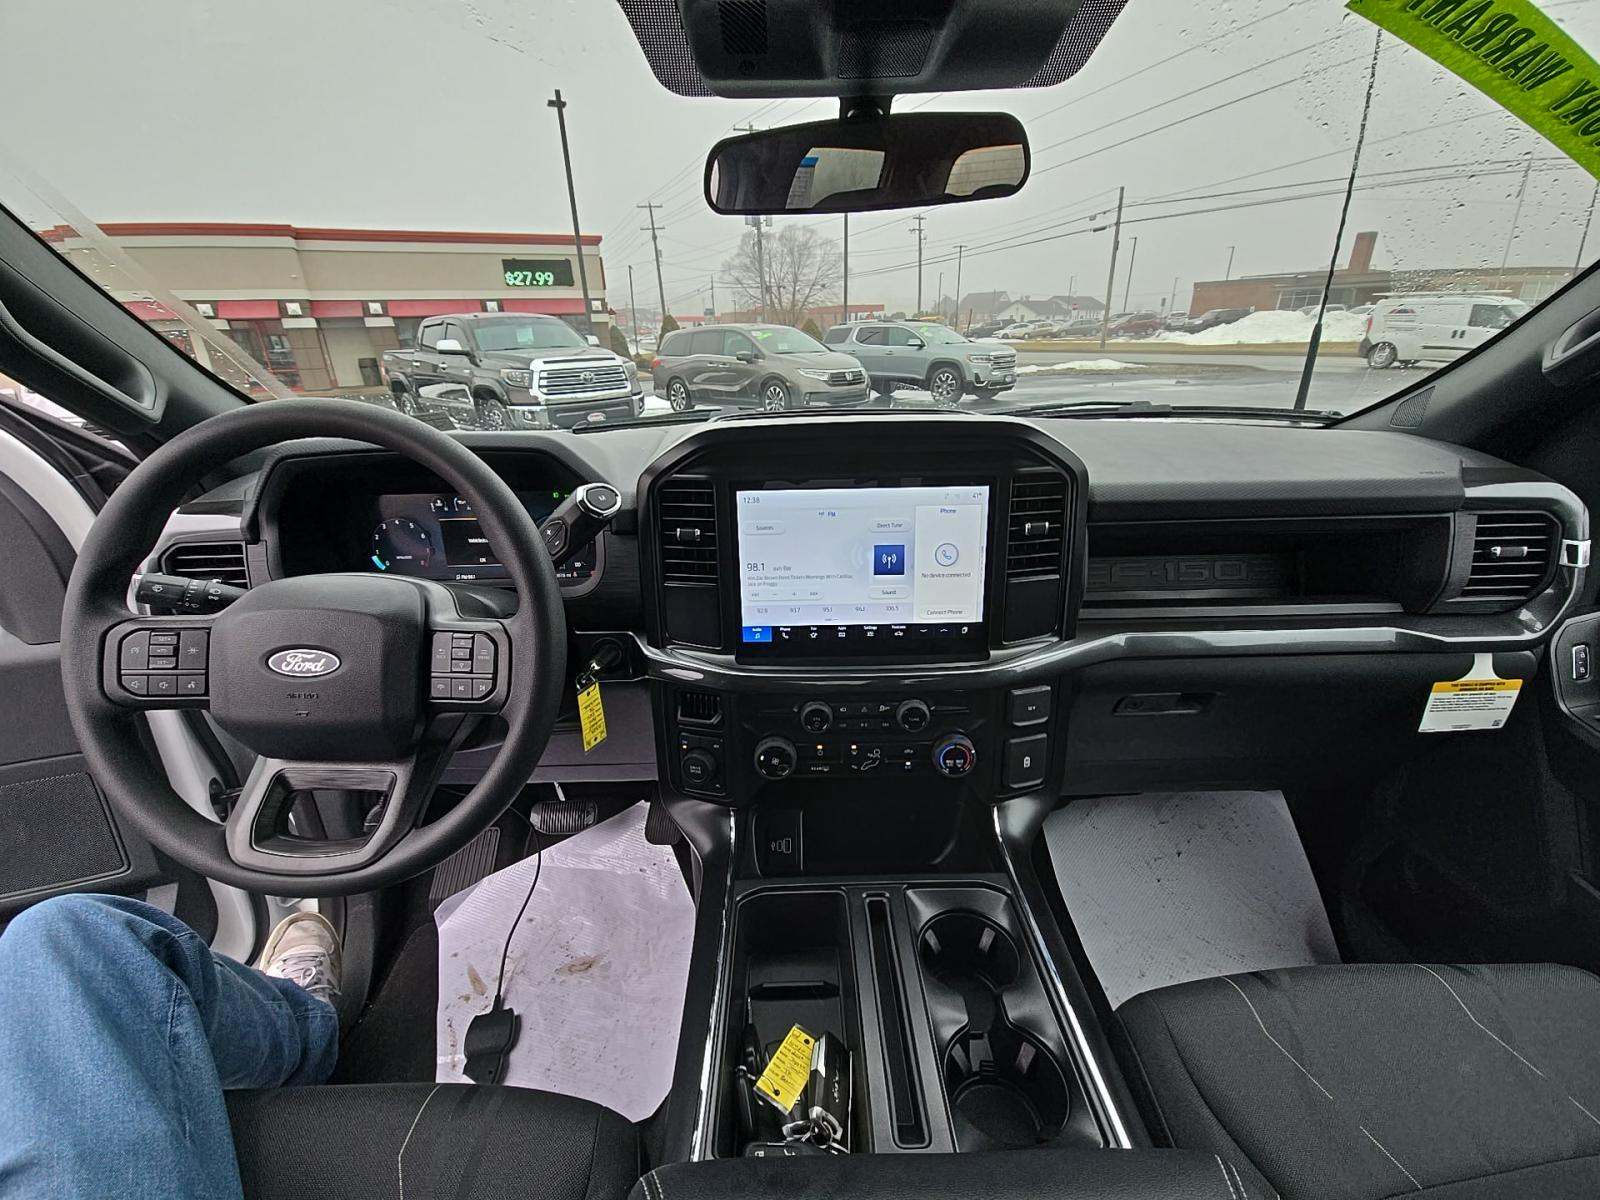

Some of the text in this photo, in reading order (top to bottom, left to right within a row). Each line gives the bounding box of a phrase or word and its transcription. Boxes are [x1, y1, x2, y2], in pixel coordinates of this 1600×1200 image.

[505, 271, 554, 286] $27.99
[746, 563, 765, 572] 98.1
[282, 653, 326, 671] Ford
